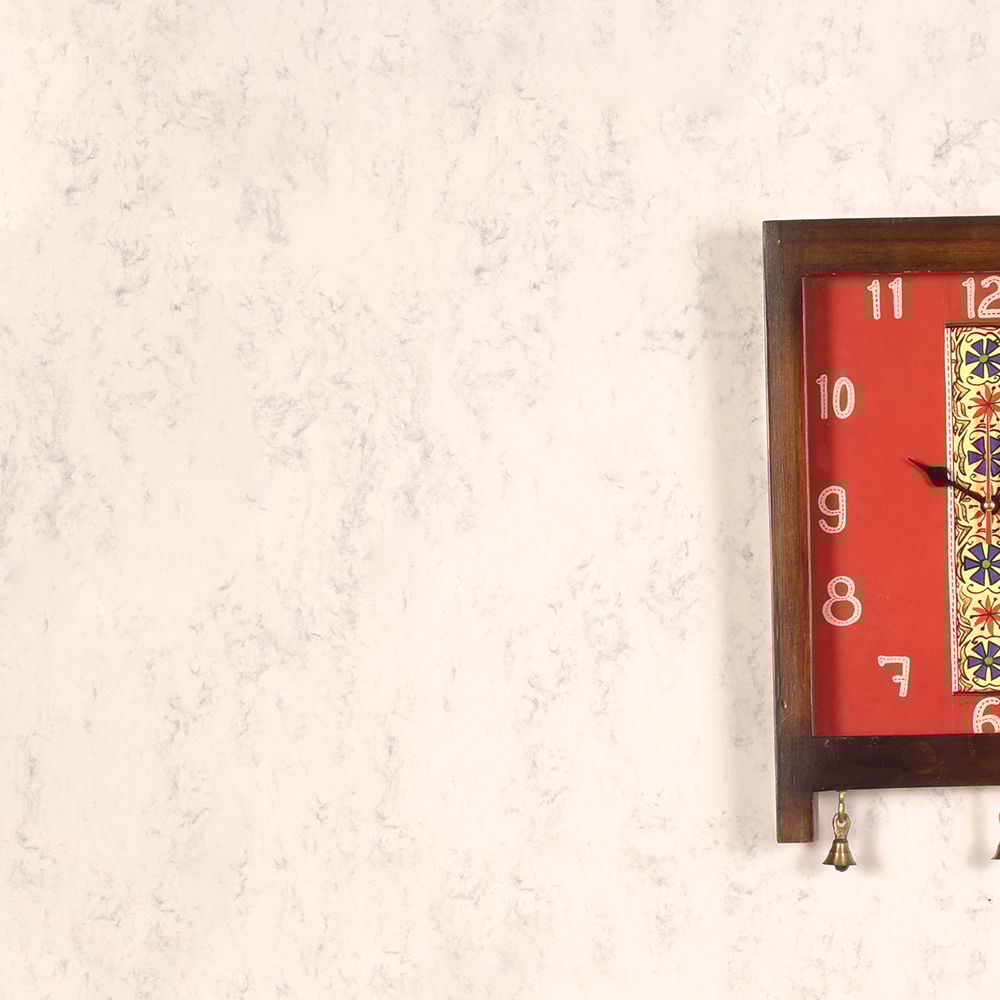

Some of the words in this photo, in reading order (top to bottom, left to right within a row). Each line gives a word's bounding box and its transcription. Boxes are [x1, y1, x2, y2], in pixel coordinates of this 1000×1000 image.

[867, 277, 902, 320] 11
[816, 375, 855, 420] 10
[818, 485, 847, 534] 9
[822, 575, 862, 627] 8
[878, 655, 911, 698] 7
